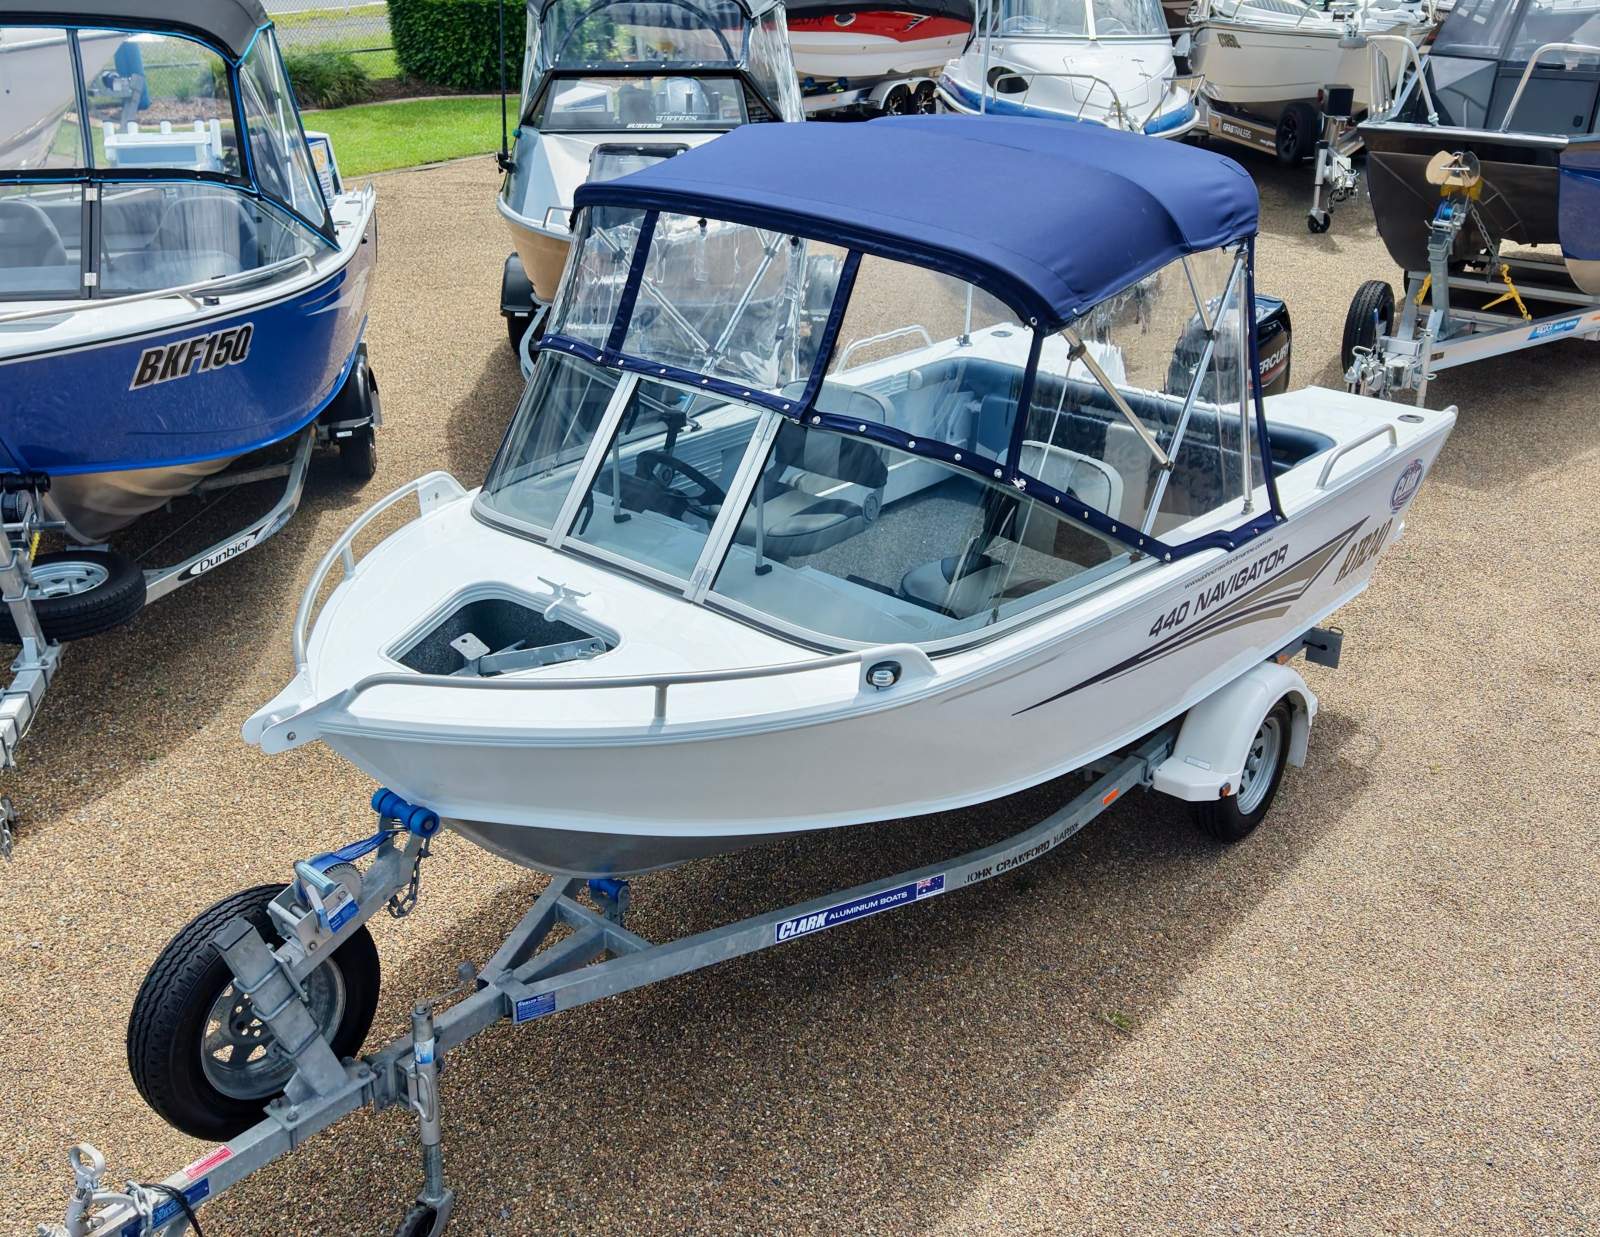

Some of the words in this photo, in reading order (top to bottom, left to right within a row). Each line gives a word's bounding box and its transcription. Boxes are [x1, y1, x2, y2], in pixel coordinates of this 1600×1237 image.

[1257, 341, 1290, 375] ERCURY
[200, 538, 250, 572] Dunbier
[1149, 600, 1191, 638] 440
[1193, 543, 1289, 616] NAVIGATOR
[964, 866, 993, 885] JOHN
[995, 840, 1051, 873] CRAWFORD
[778, 911, 829, 941] CLARK
[828, 899, 879, 922] ALUMINIUM
[879, 890, 909, 906] BOATS
